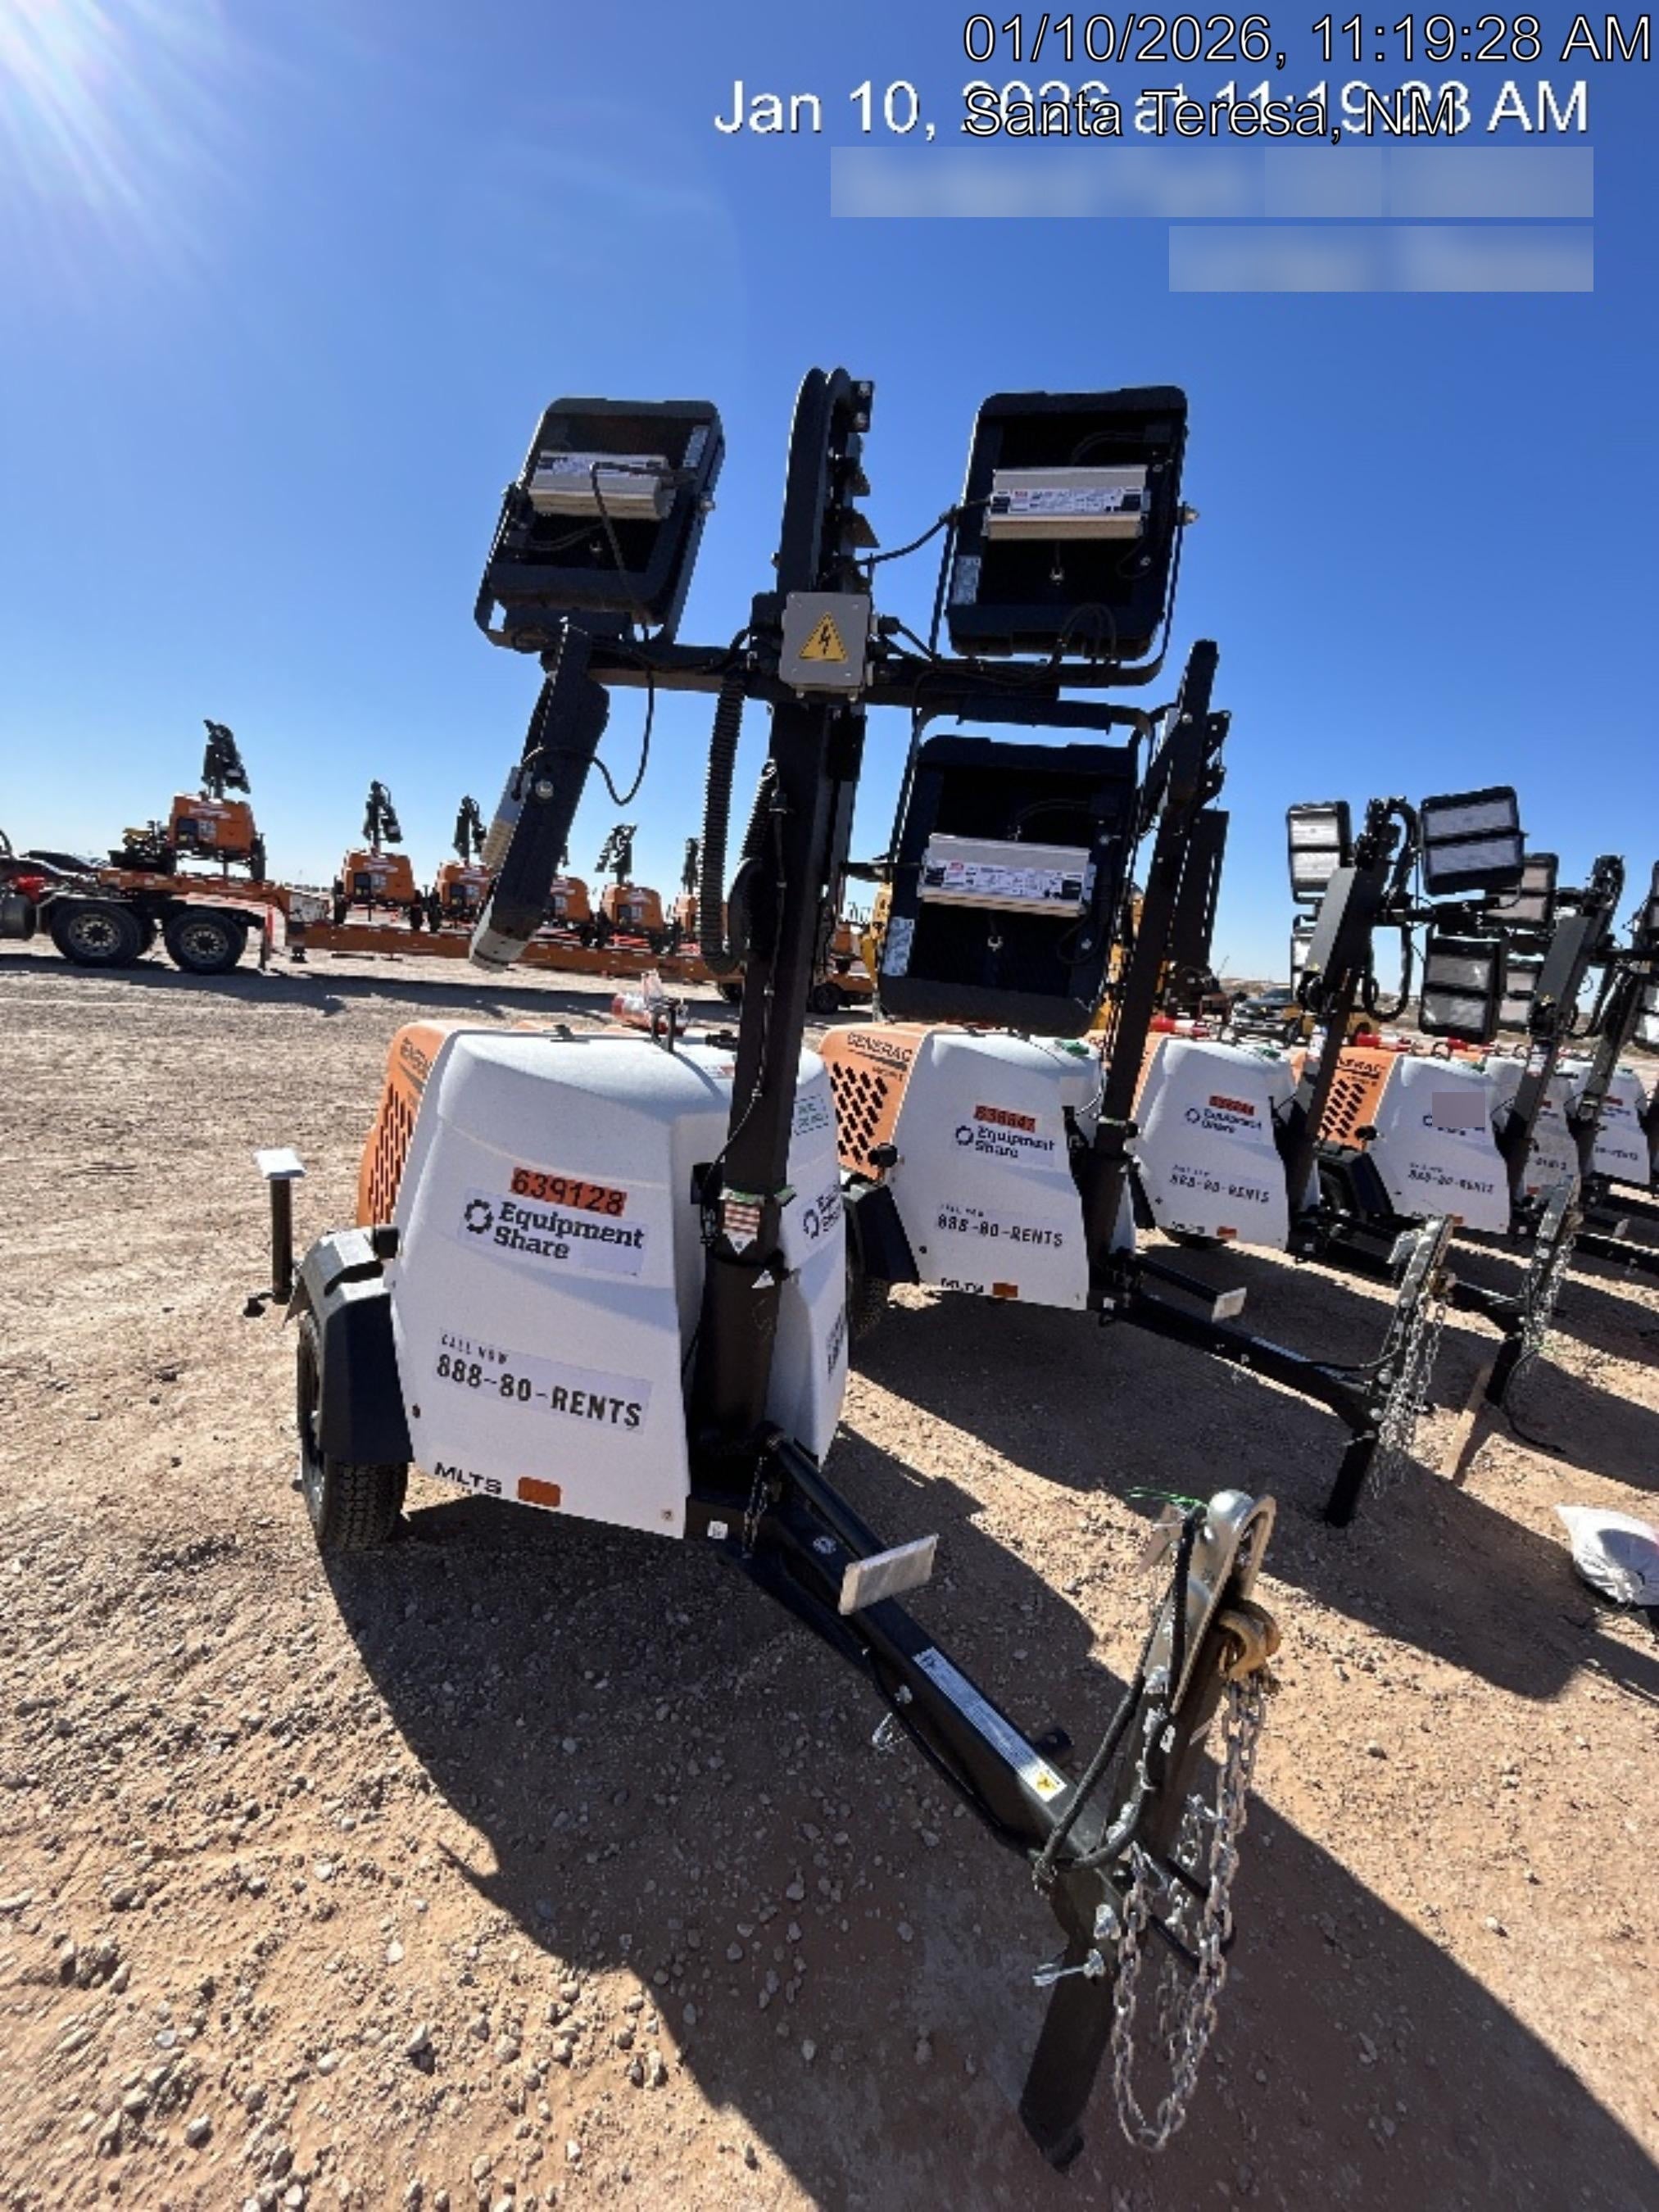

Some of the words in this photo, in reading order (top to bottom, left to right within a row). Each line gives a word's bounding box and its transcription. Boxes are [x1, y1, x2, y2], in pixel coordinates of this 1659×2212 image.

[511, 1168, 626, 1216] 639128
[493, 1226, 571, 1259] Share
[498, 1201, 645, 1249] Equipment
[437, 1353, 643, 1428] 888-80-RENTS
